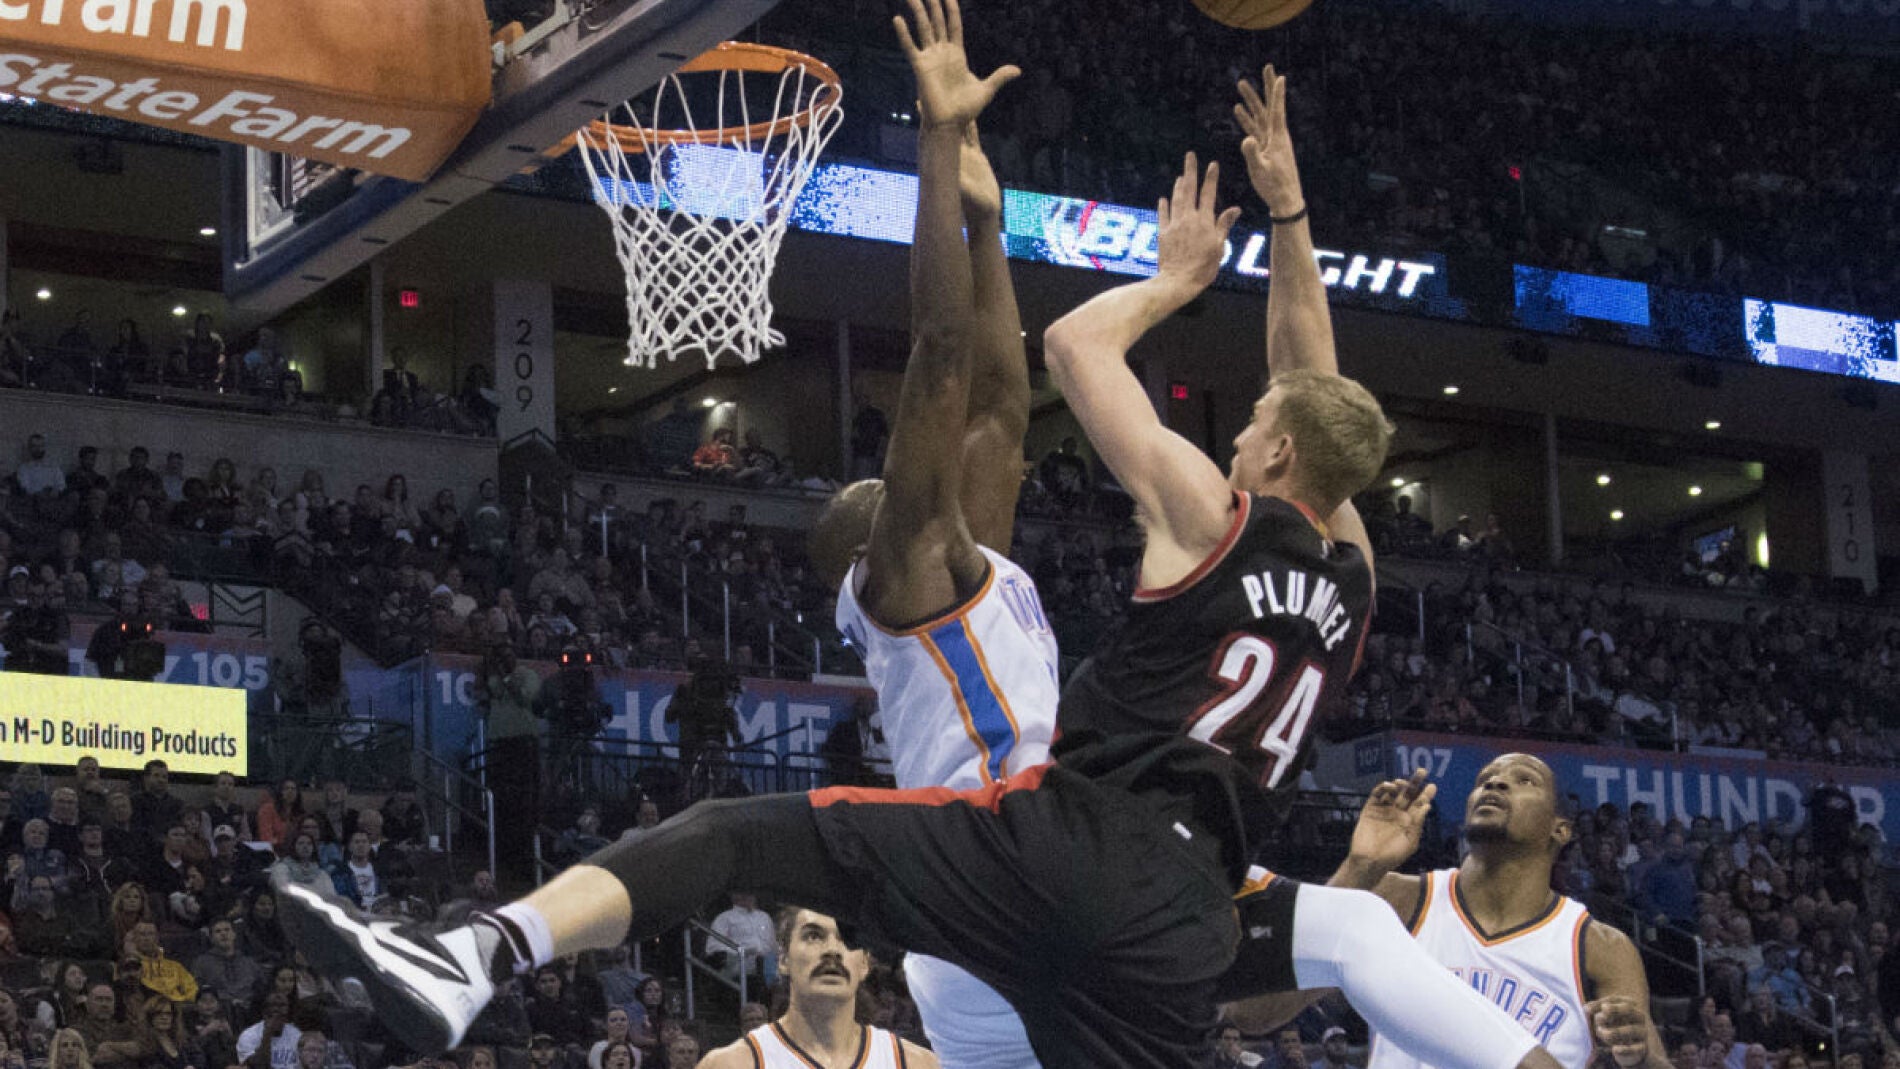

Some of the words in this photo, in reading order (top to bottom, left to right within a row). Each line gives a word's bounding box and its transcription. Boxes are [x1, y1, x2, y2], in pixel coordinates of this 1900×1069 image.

[1236, 231, 1435, 298] LGHT
[515, 319, 533, 412] 209
[193, 651, 269, 691] 105
[14, 717, 54, 744] M-D
[62, 720, 145, 756] Building
[151, 726, 237, 757] Products
[1187, 634, 1326, 790] 24
[1396, 746, 1452, 778] 107
[1582, 764, 1886, 842] THUNDR
